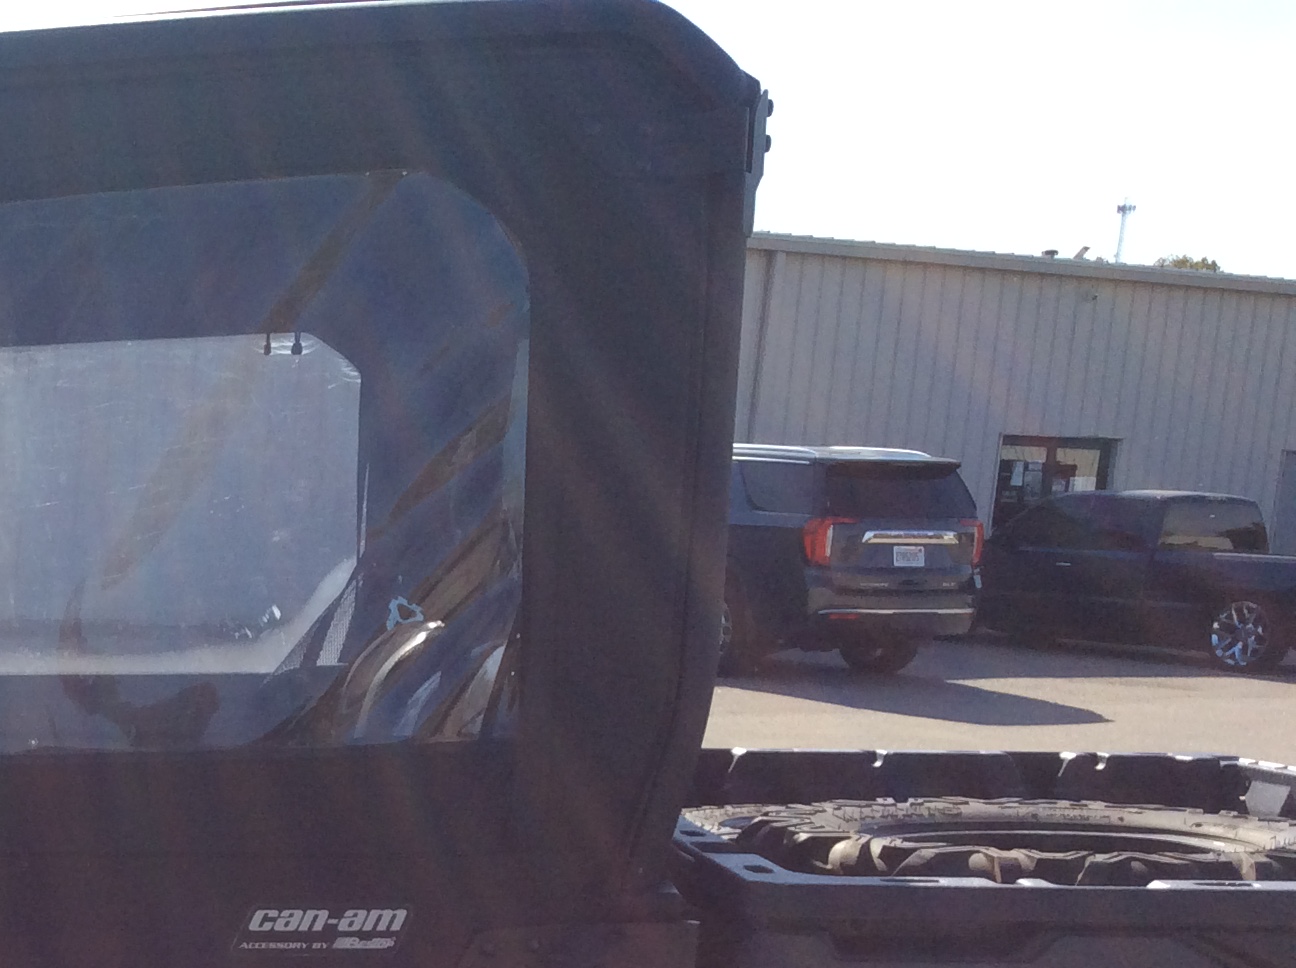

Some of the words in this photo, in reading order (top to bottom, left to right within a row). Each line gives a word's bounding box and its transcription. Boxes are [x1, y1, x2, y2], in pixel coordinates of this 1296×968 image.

[248, 908, 408, 932] can-am
[238, 941, 309, 950] ACCESSORY
[311, 941, 330, 950] BY
